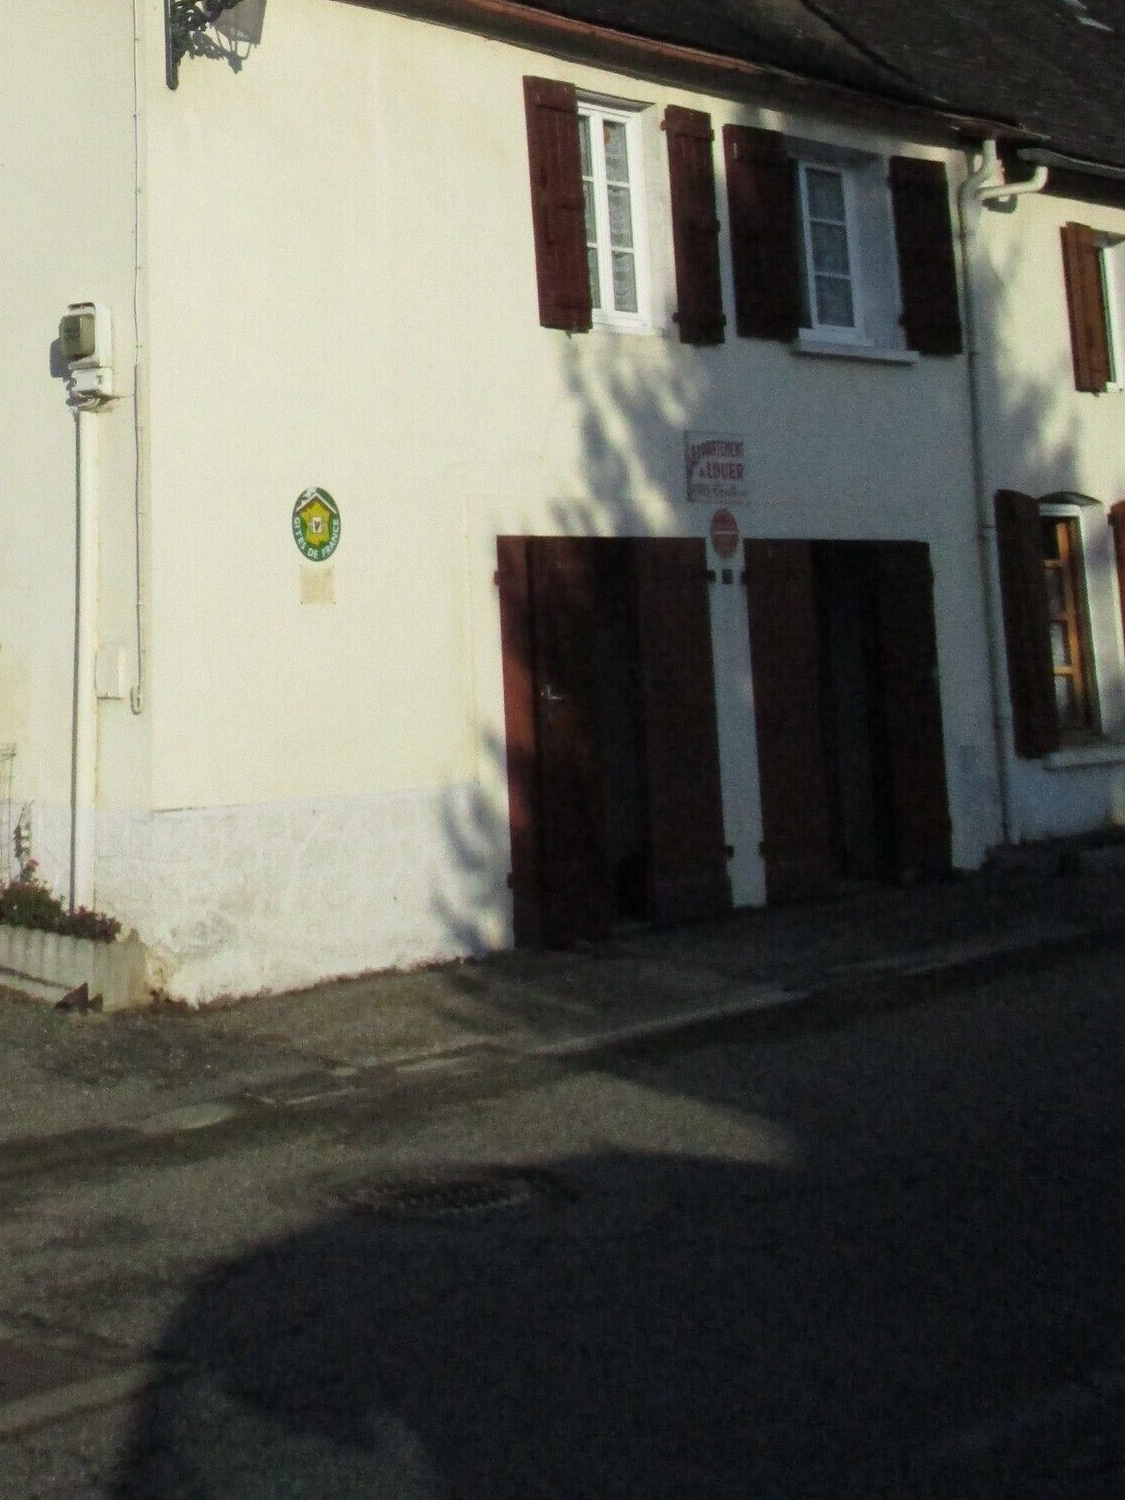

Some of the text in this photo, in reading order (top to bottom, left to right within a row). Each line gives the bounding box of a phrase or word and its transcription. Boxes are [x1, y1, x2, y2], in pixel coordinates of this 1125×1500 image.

[707, 461, 744, 479] LOUER
[307, 547, 319, 558] DE
[322, 519, 339, 558] FRANCE
